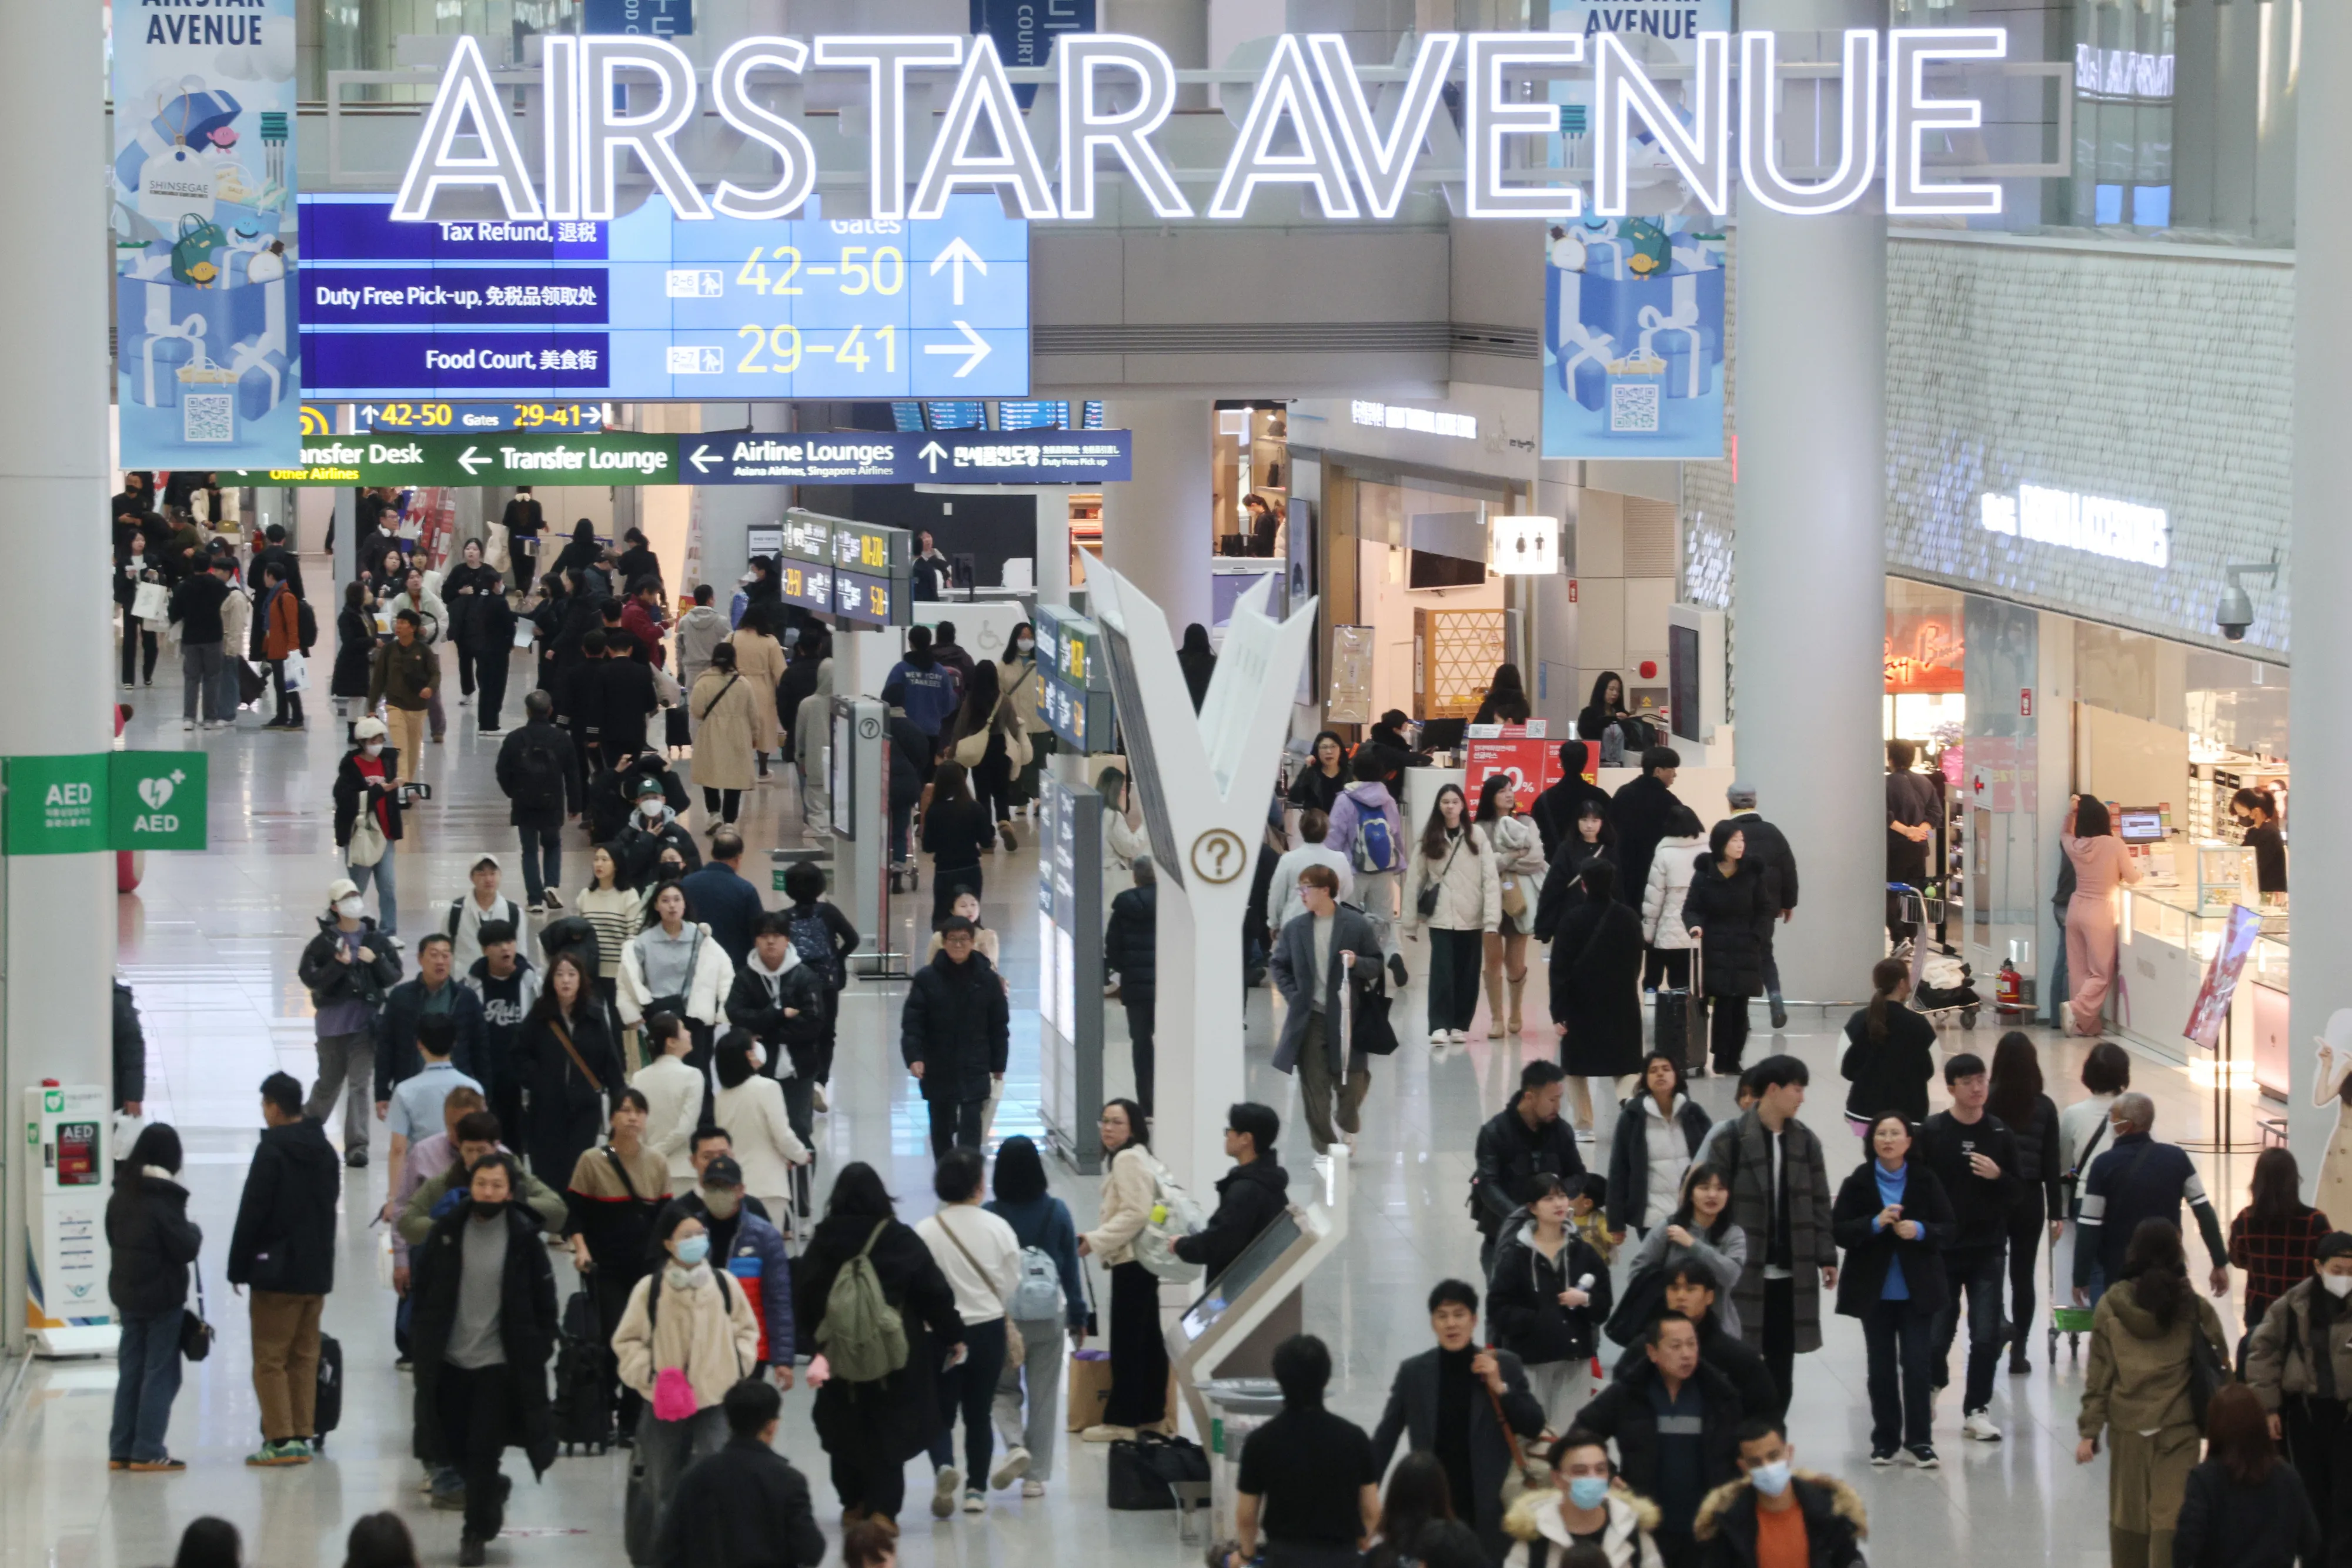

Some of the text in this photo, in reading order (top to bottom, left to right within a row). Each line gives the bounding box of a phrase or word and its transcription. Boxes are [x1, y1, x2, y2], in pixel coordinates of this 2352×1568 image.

[146, 14, 262, 45] AVENUE
[1584, 9, 1698, 39] AVENUE
[1017, 5, 1034, 65] COURT
[390, 26, 2007, 222] AIRSTAR AVENUE
[149, 180, 208, 193] SHINSEGAE
[439, 222, 596, 243] Tax Refund, 退税
[831, 219, 901, 235] Gates
[316, 285, 597, 310] Duty Free Pick-up, 免税品领取处
[426, 349, 598, 371] Food Court, 美食街
[380, 404, 581, 427] 42-50 Gates 29-41
[369, 443, 424, 464] Desk
[500, 445, 669, 472] Transfer Lounge
[732, 441, 894, 466] Airline Lounges
[953, 446, 1040, 467] 면세품인도장
[1041, 457, 1108, 467] Duty Free Pick up
[270, 467, 360, 480] Other Airlines
[733, 466, 894, 478] Asiana Airlines, Singapore Airlines
[45, 783, 92, 806] AED
[133, 814, 179, 833] AED
[64, 1124, 94, 1139] AED
